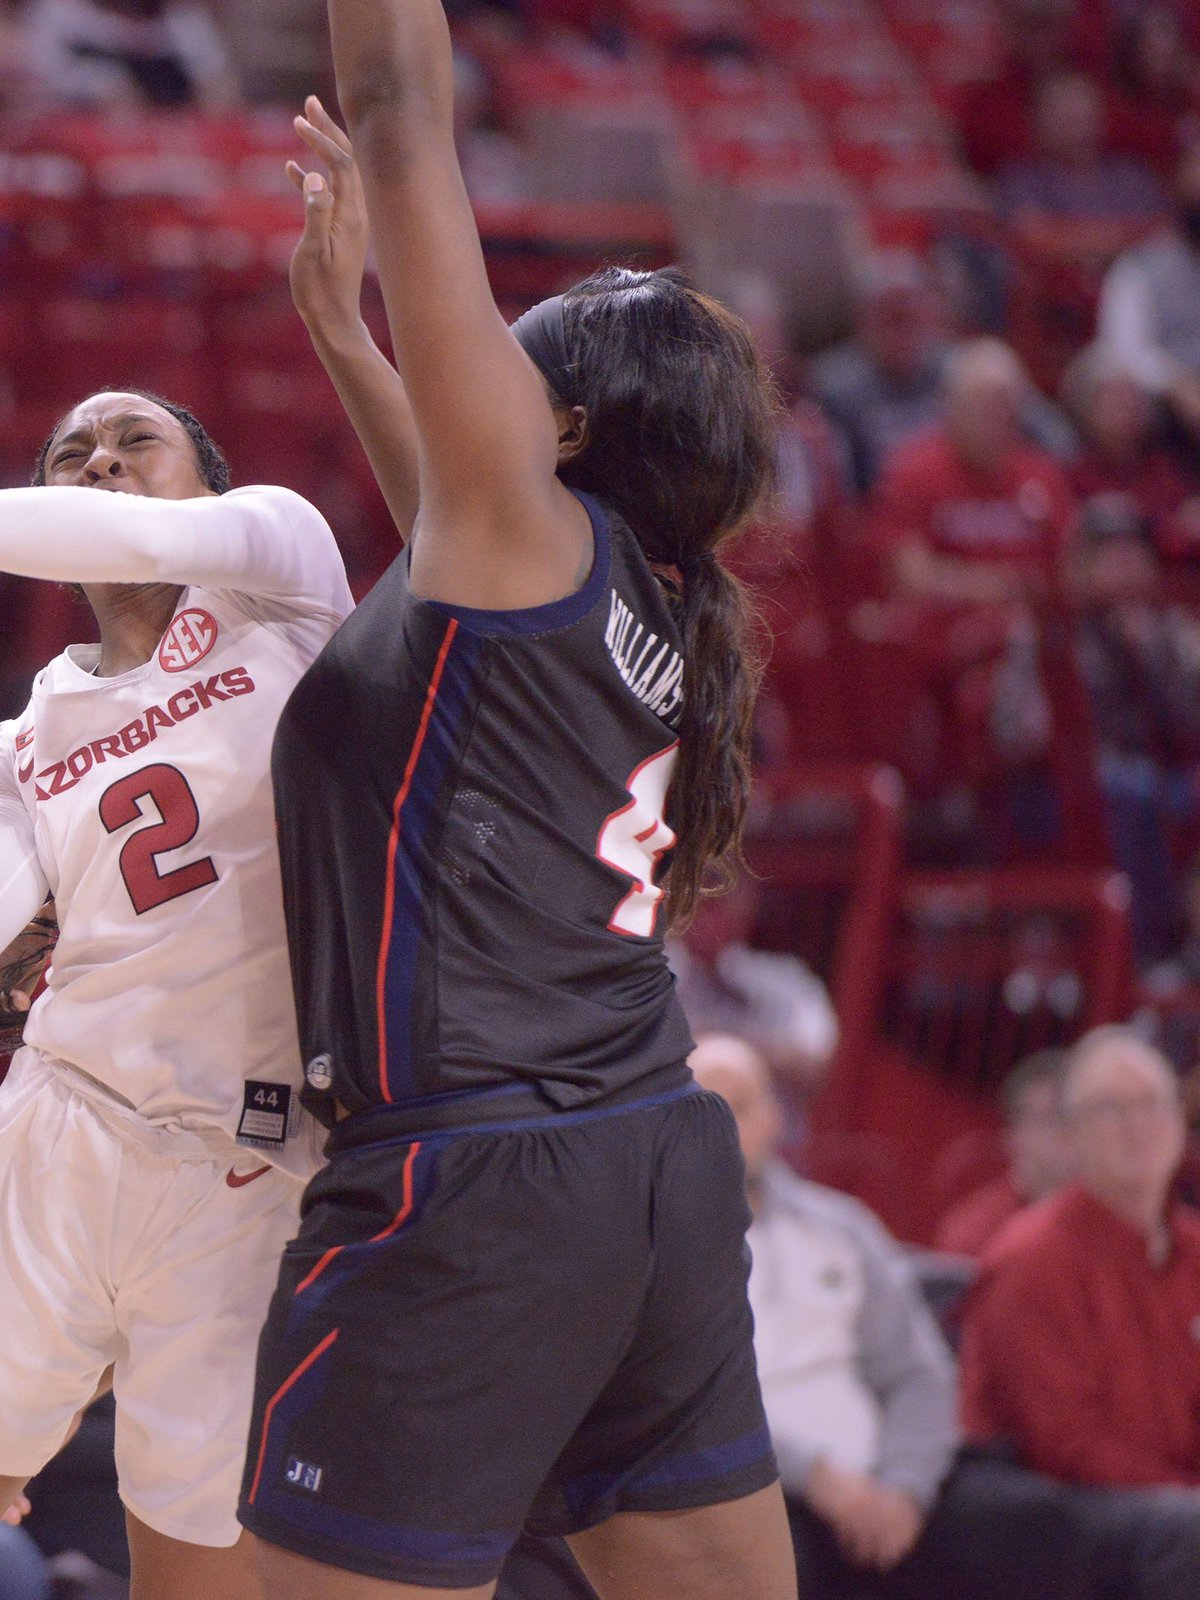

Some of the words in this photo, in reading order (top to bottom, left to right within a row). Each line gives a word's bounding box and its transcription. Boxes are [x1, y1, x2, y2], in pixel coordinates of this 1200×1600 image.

[160, 612, 213, 668] SEC
[99, 763, 219, 916] 2
[595, 738, 677, 937] 4
[253, 1089, 278, 1107] 44
